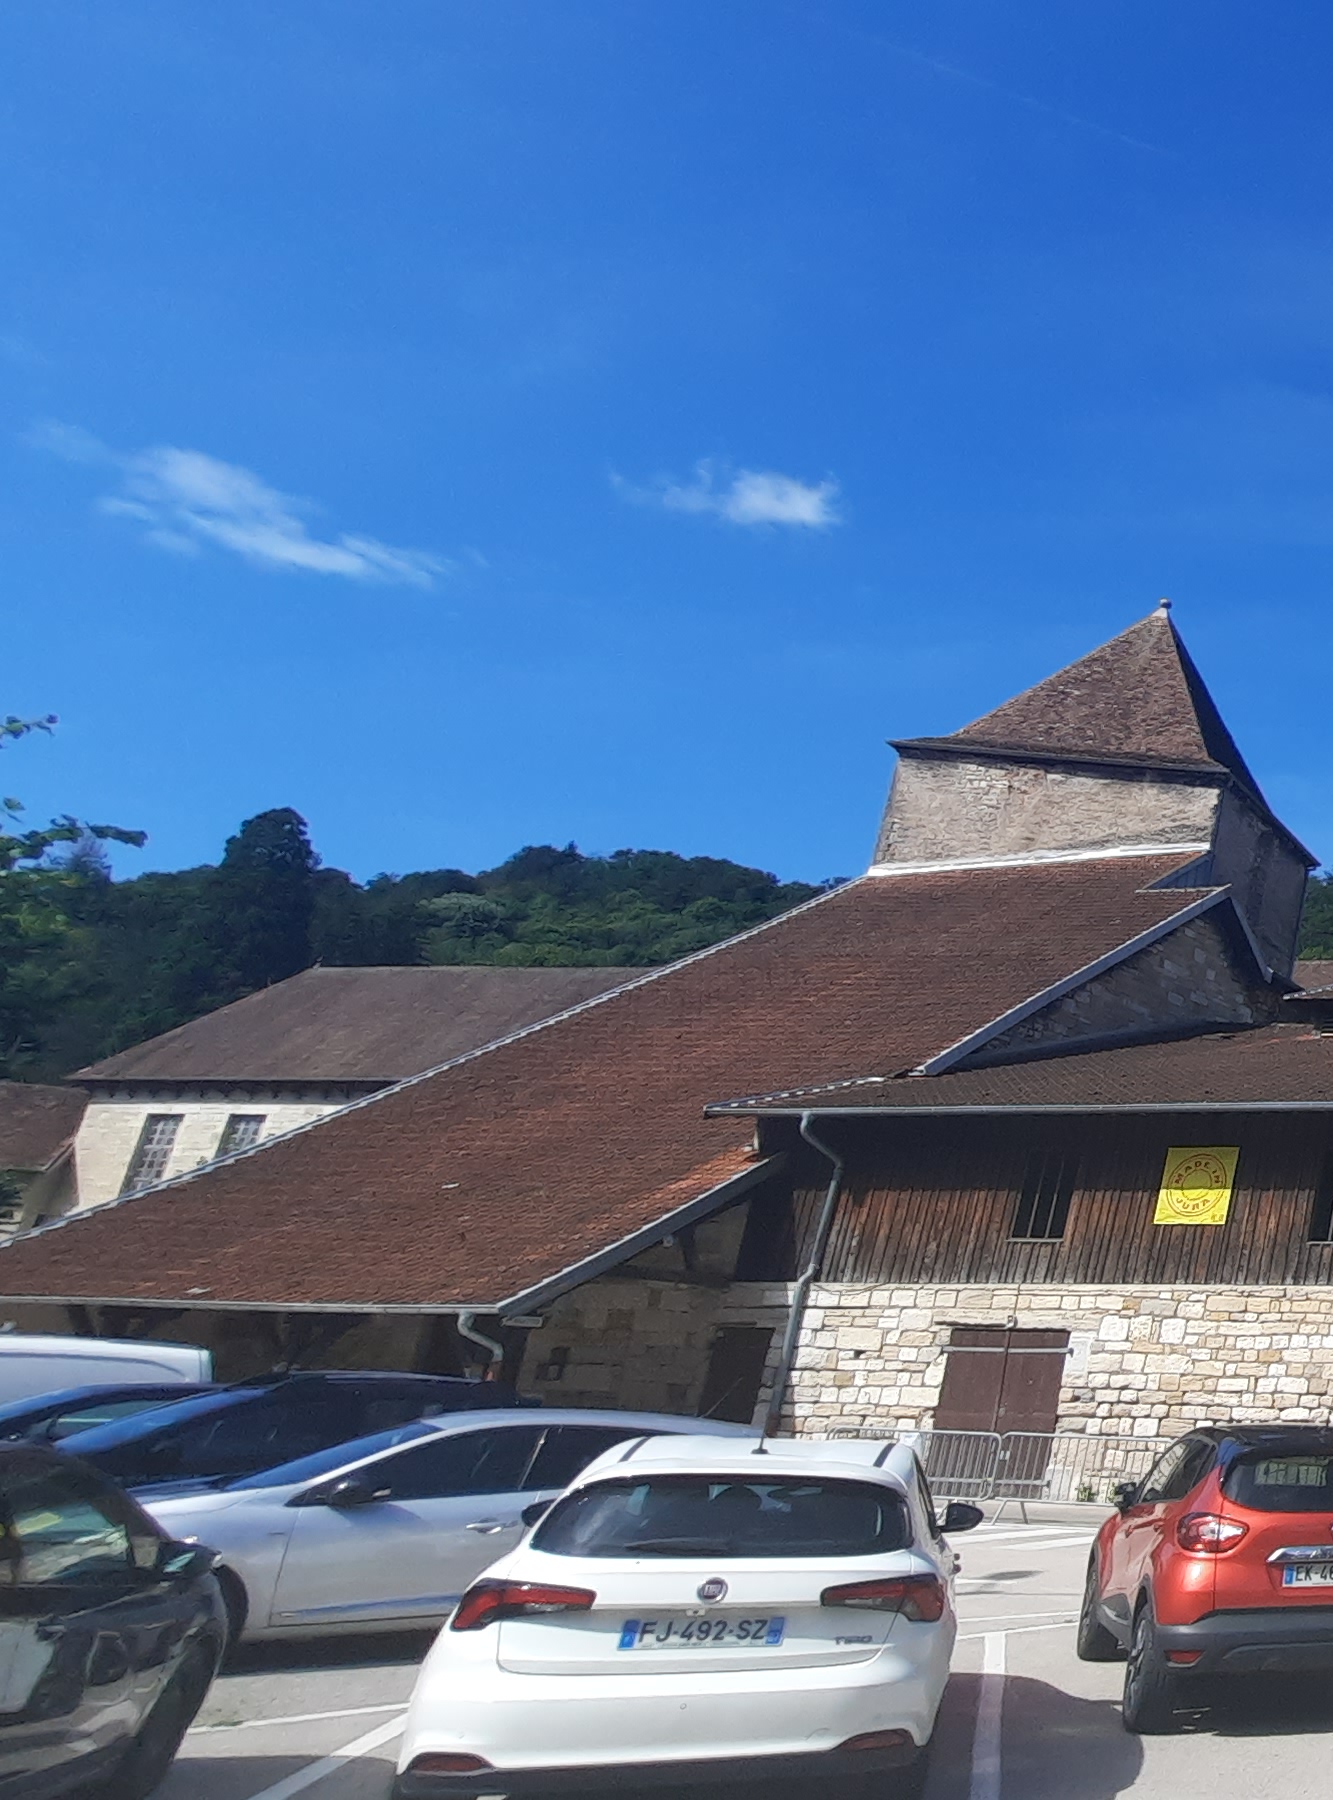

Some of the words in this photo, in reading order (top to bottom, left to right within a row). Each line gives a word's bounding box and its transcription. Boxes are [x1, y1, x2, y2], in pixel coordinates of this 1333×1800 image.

[1174, 1160, 1211, 1185] MADE
[1176, 1197, 1211, 1211] JURA
[638, 1619, 768, 1643] FJ-492-SZ
